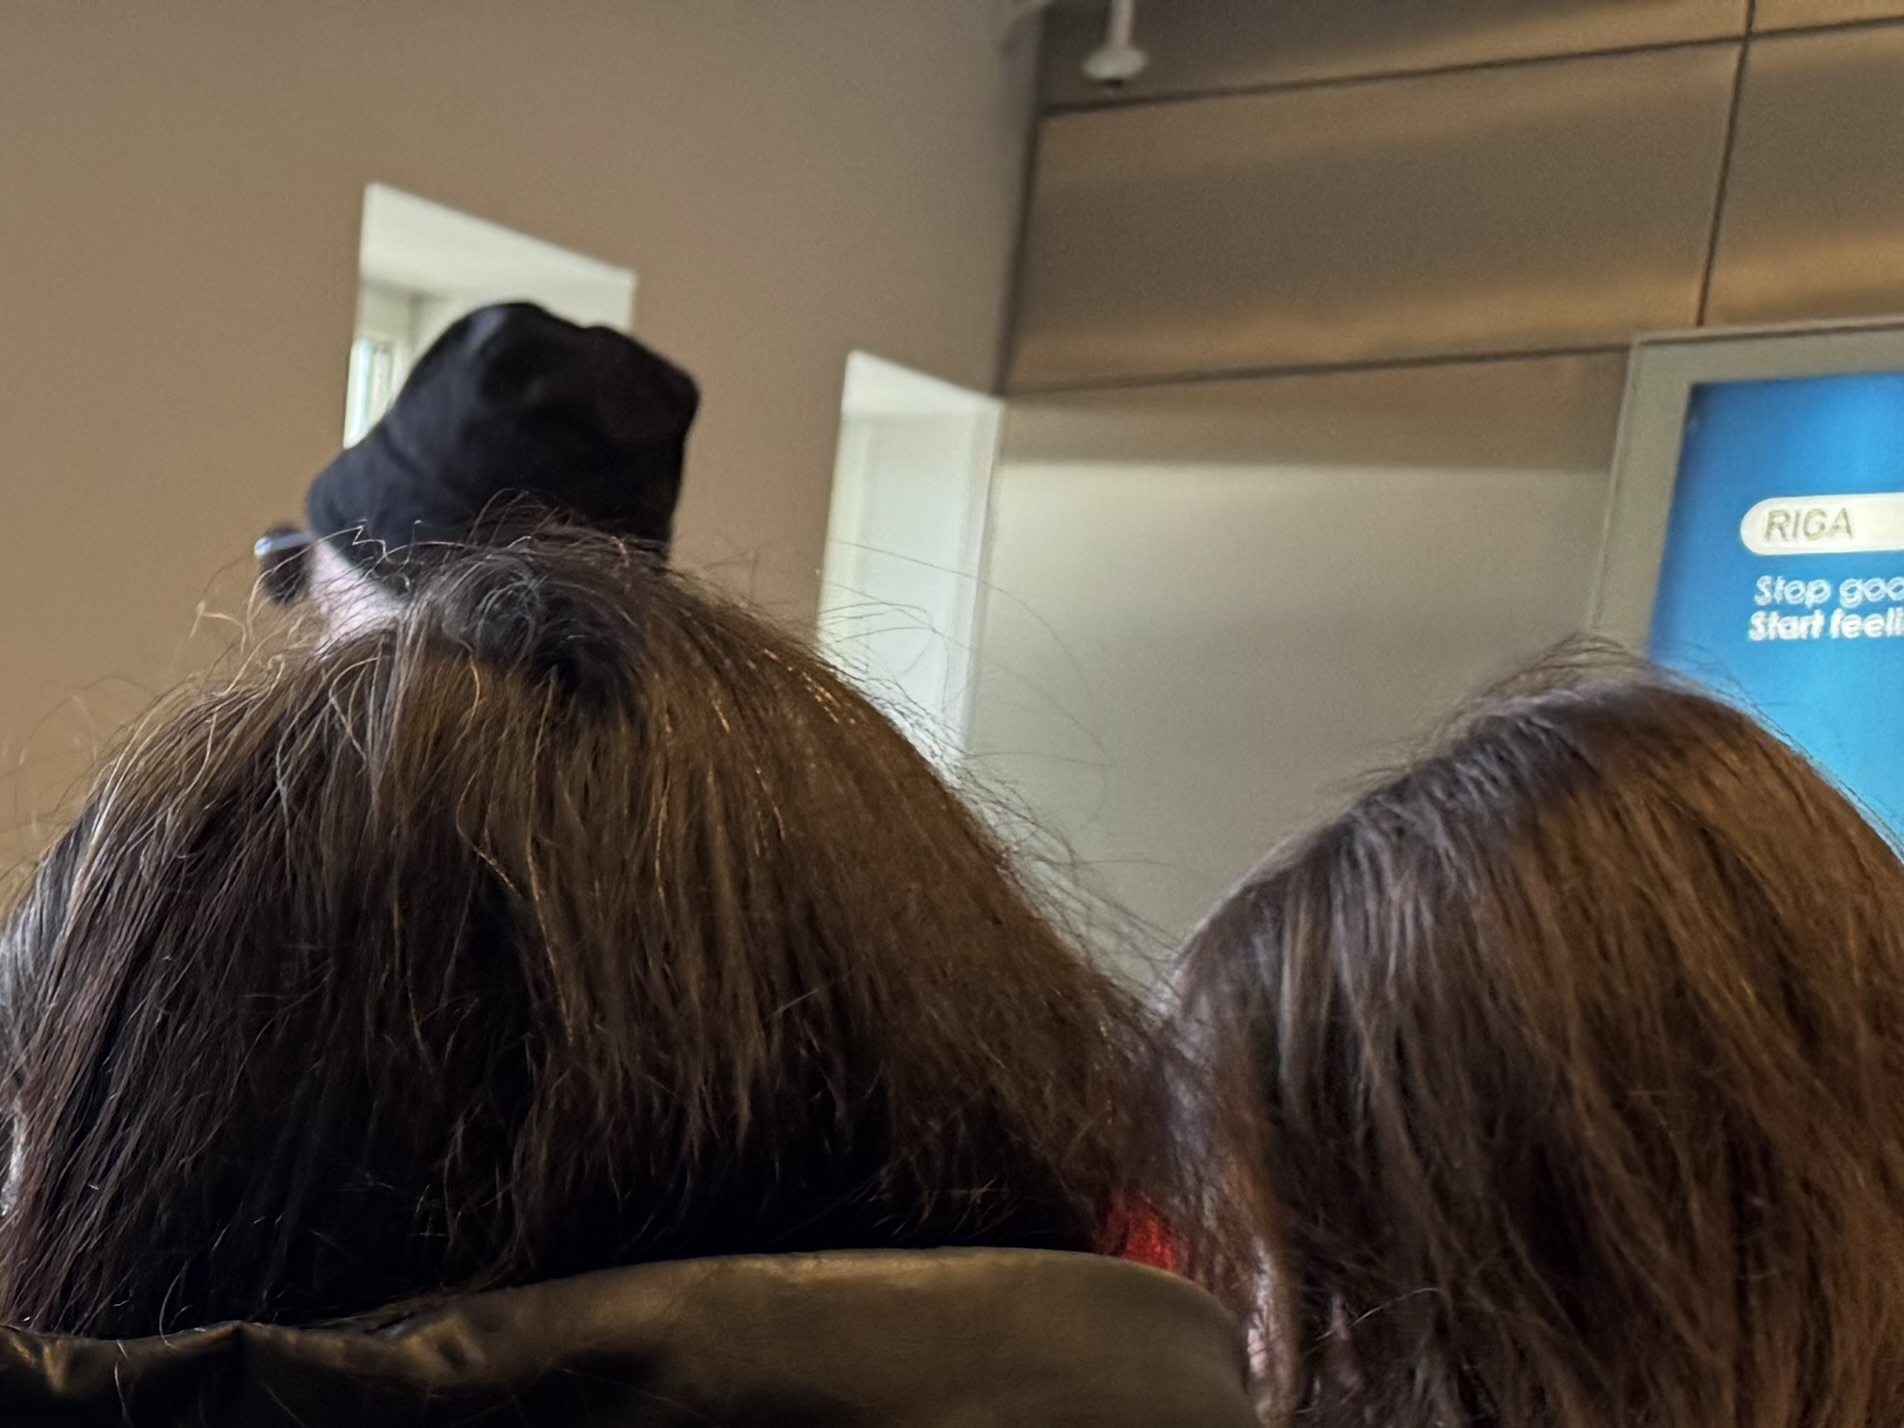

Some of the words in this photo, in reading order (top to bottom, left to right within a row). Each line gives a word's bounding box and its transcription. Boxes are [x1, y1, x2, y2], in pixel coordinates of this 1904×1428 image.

[1764, 508, 1853, 541] RIGA
[1754, 575, 1832, 609] Stop
[1748, 609, 1825, 641] Start
